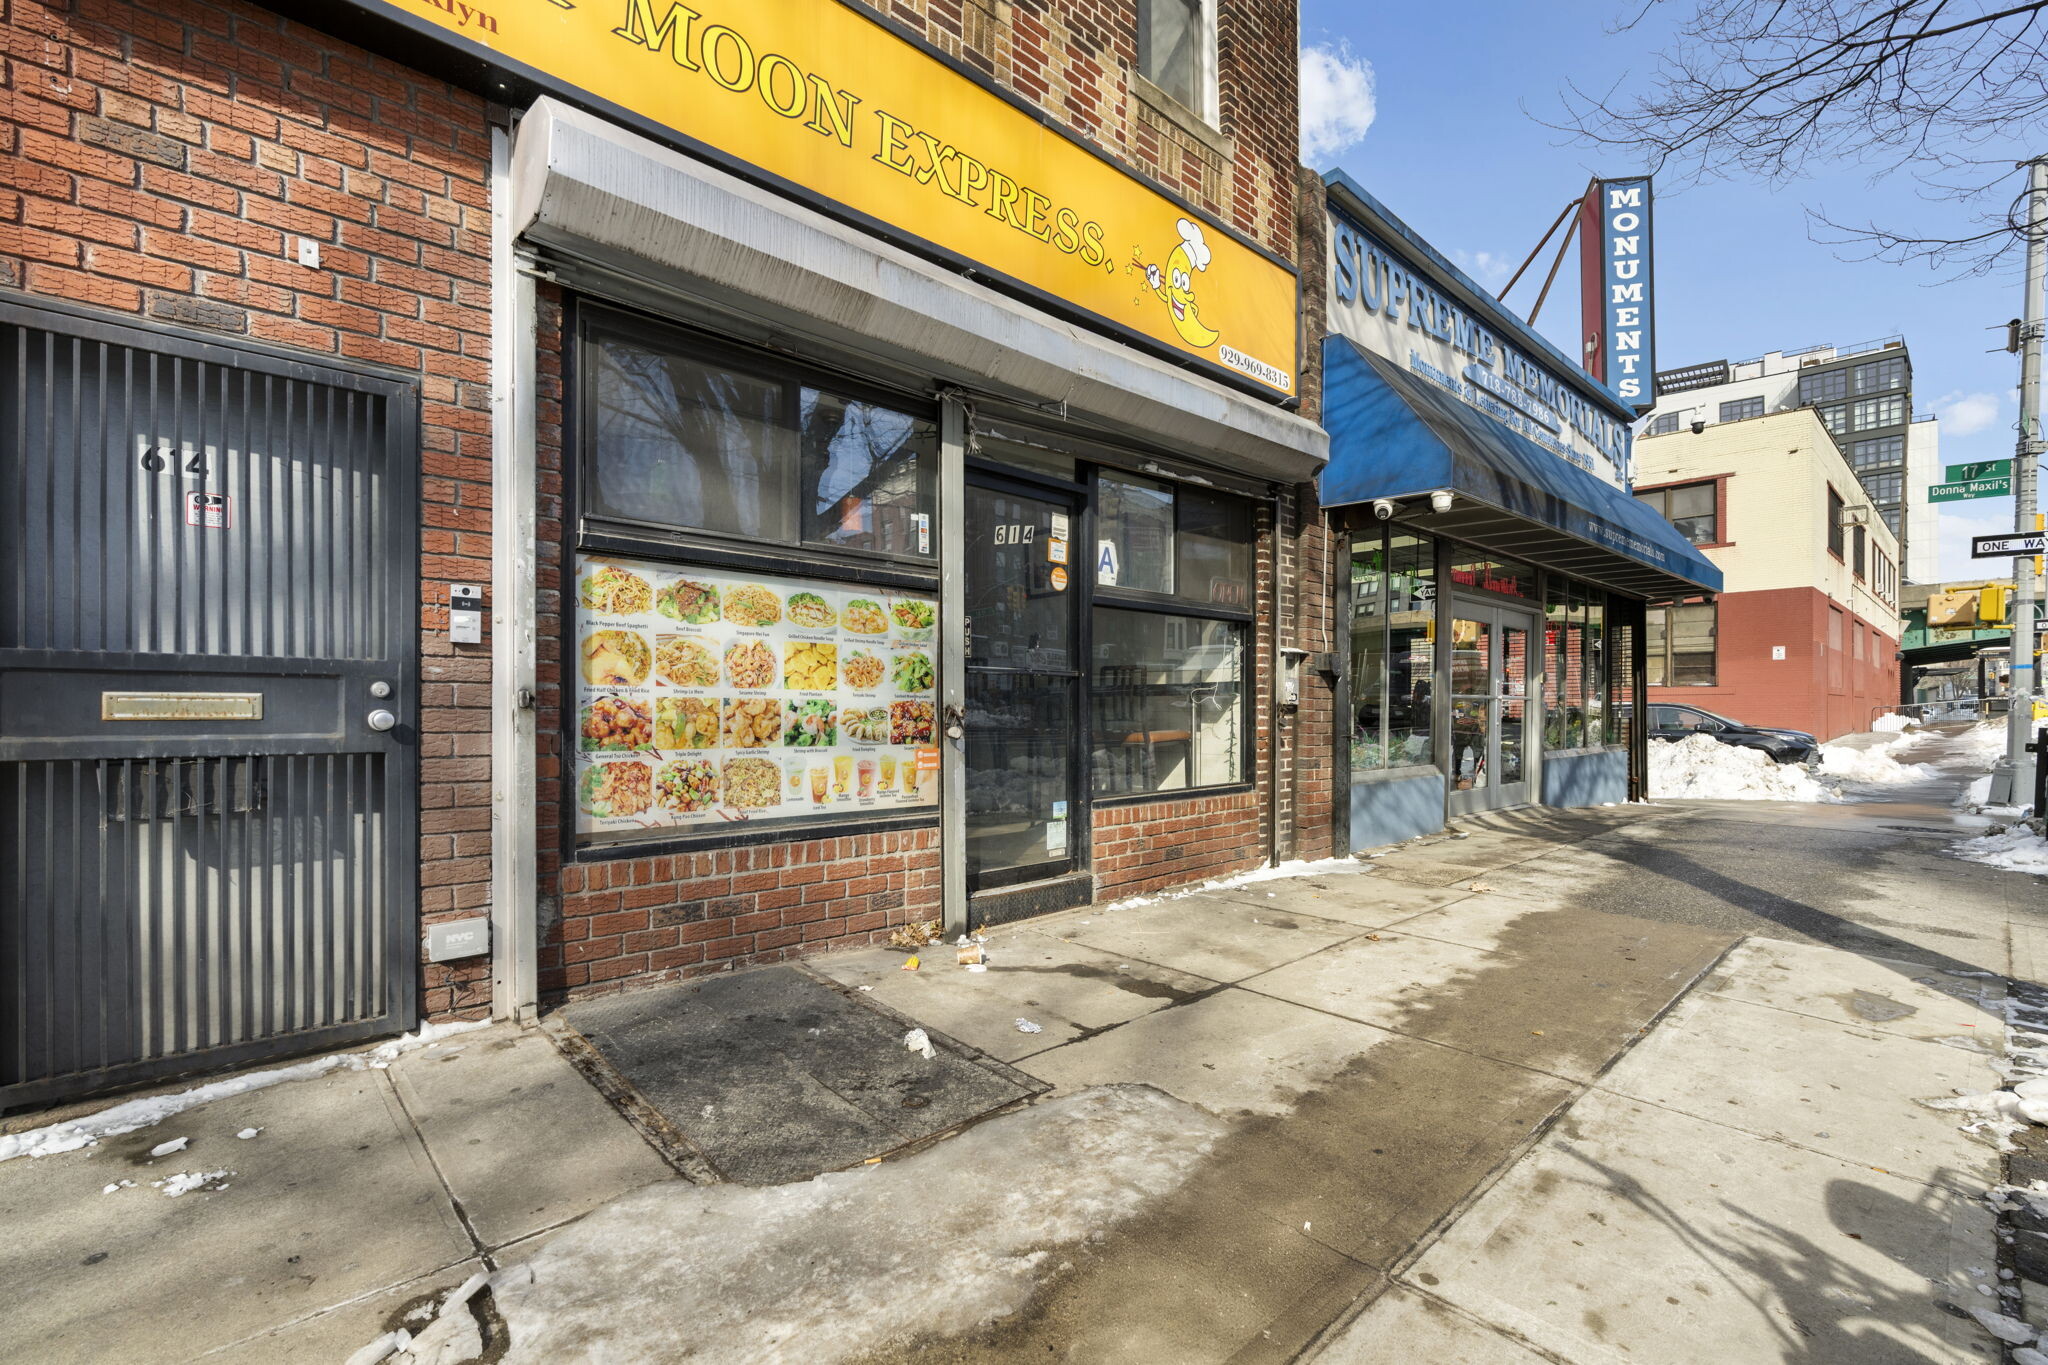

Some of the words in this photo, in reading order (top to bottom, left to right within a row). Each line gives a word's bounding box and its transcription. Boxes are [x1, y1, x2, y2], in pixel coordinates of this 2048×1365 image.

[611, 0, 861, 147] MOON
[872, 110, 1115, 273] EXPRESS.
[1610, 188, 1643, 398] MONUMENTS
[1334, 221, 1496, 367] SUPREME
[1503, 344, 1625, 469] MEMORIALS
[1220, 346, 1289, 389] 929-969-8315
[1410, 349, 1462, 395] Monuments
[1481, 370, 1549, 424] 718-788-7986
[1961, 464, 1978, 479] 17
[1985, 463, 1996, 472] St
[1932, 485, 1965, 496] Donna
[1969, 480, 2009, 492] Maxil's
[193, 504, 225, 513] WRNIN
[996, 526, 1034, 543] 614
[1982, 541, 2009, 552] ONE
[1098, 546, 1114, 574] A
[446, 931, 473, 943] NYC
